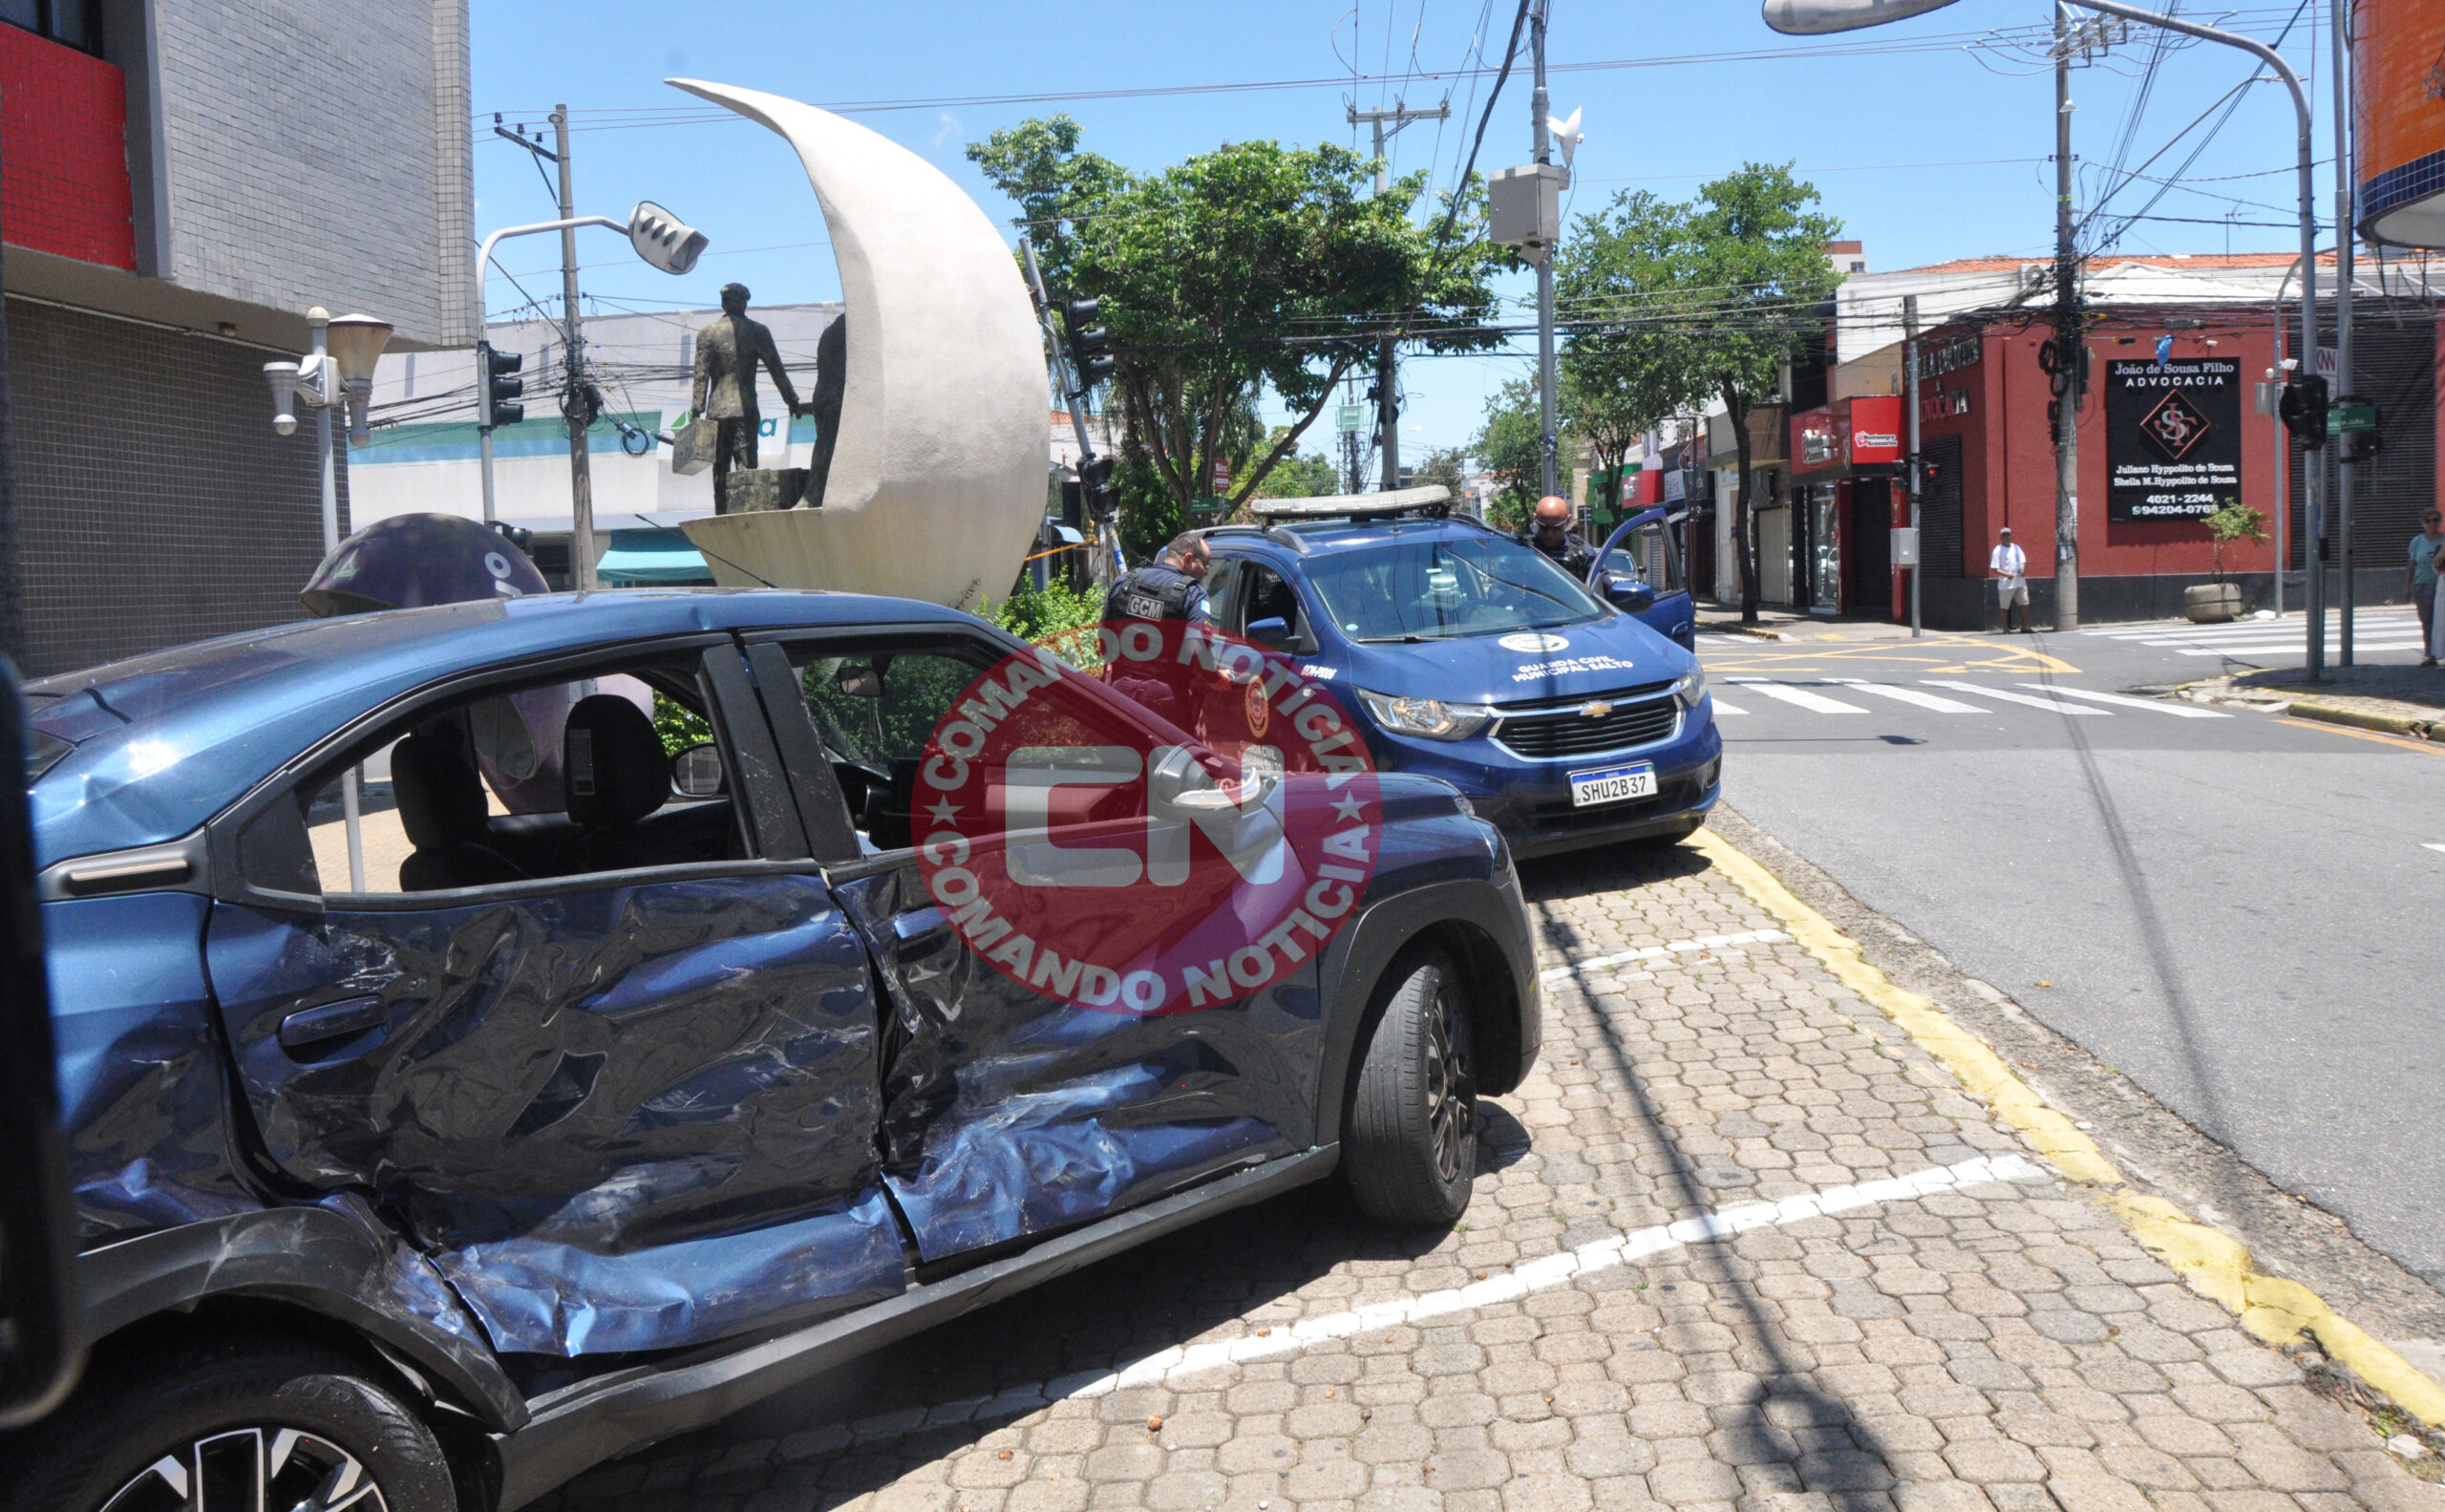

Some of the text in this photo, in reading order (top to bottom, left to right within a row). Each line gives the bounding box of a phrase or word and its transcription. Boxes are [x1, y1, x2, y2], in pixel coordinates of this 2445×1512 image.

[2115, 362, 2235, 375] João de Sousa Filho
[2125, 375, 2224, 388] ADVOCACIA
[1918, 388, 1968, 423] DVOCACIA
[2115, 463, 2235, 476] Juliano Hyppolito de Sousa
[2114, 478, 2141, 487] Sheila
[2198, 477, 2209, 485] de
[2211, 476, 2238, 484] Sousa
[1130, 597, 1162, 619] GCM
[1512, 660, 1634, 682] MUNICIPAL SALTO
[1518, 655, 1616, 672] GUARDA CIVIL
[1262, 746, 1277, 760] CIVIL
[1582, 776, 1647, 802] SHU2B37
